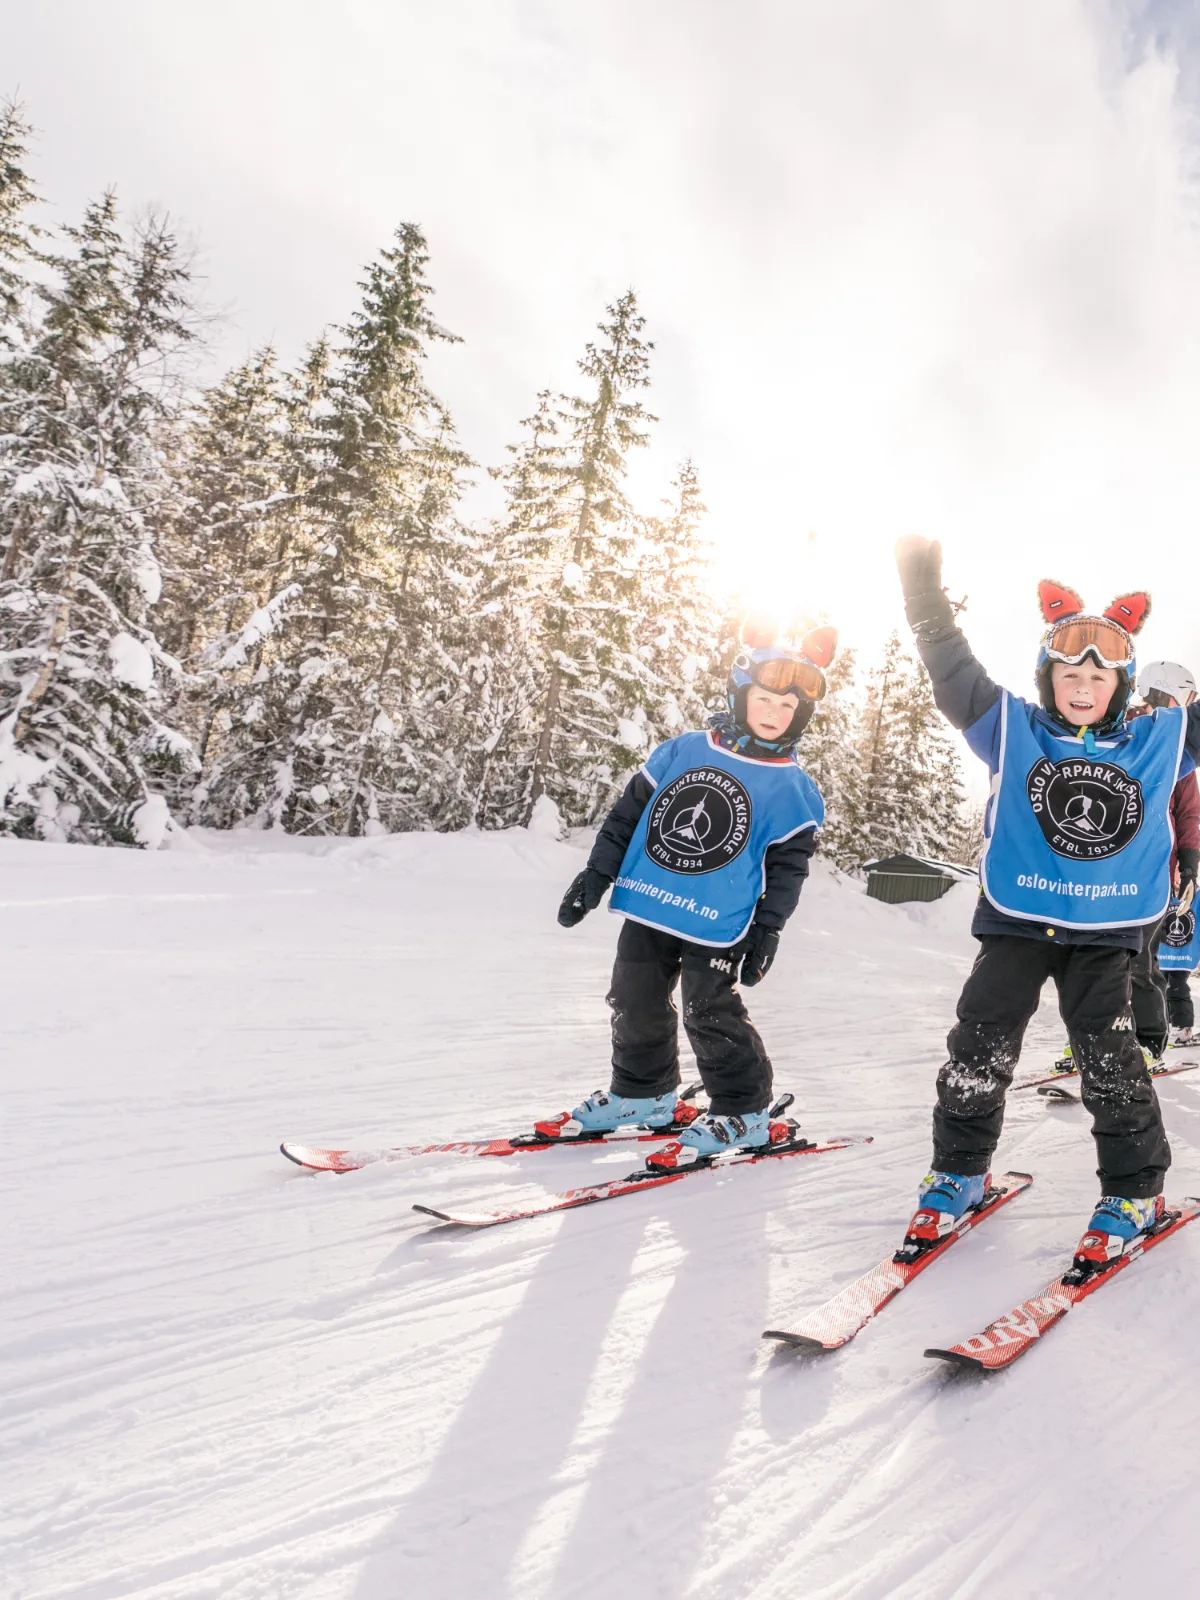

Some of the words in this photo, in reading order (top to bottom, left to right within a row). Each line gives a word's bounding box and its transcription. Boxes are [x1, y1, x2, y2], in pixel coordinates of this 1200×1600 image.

[1030, 776, 1046, 813] OSLO
[1040, 762, 1115, 783] VIRPARK
[652, 797, 670, 827] OSLO
[669, 771, 738, 796] VINTERPARK
[723, 795, 748, 855] SKISKOLE
[652, 843, 672, 863] ETBL.
[675, 858, 703, 868] 1934
[1052, 834, 1084, 855] ETBL.
[615, 875, 719, 921] oslovinterpark.no
[1017, 873, 1138, 900] oslovinterpark.no
[709, 957, 733, 974] HH
[1111, 1016, 1133, 1031] HH
